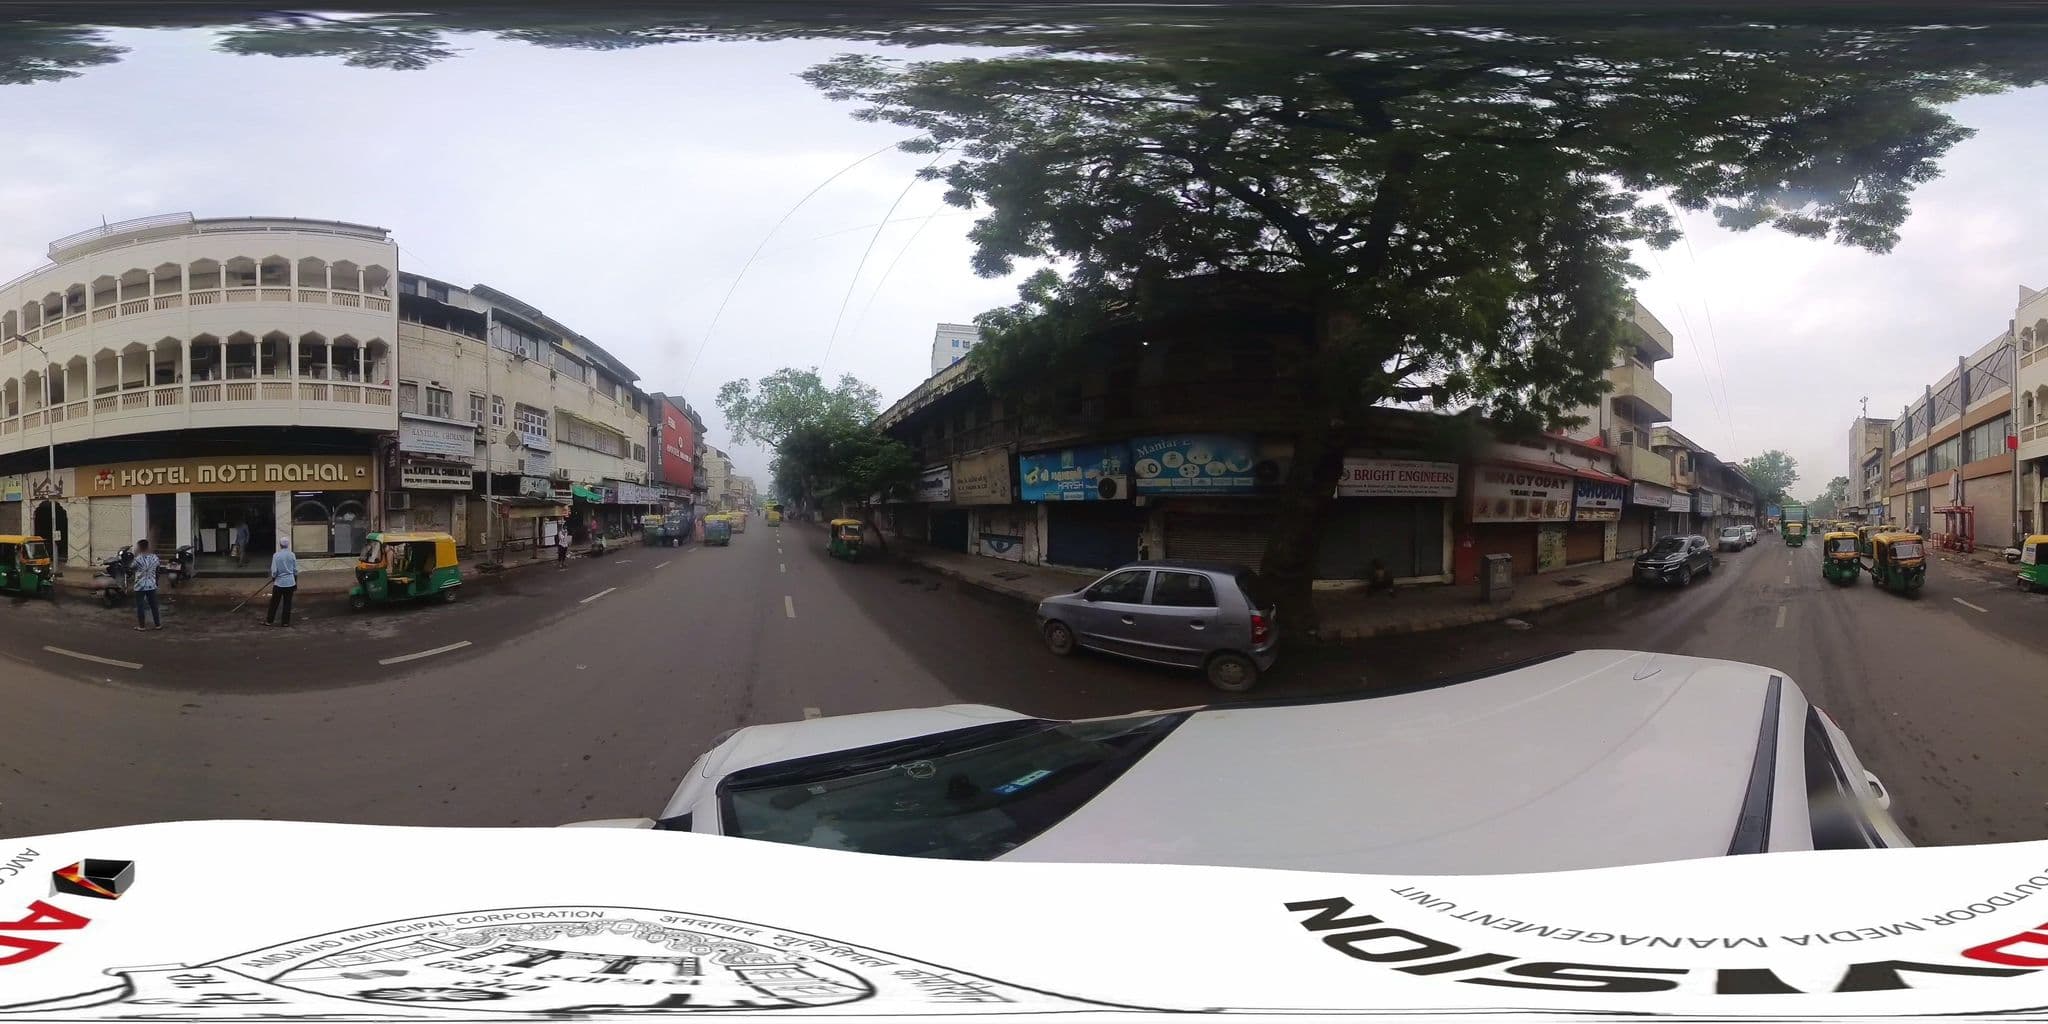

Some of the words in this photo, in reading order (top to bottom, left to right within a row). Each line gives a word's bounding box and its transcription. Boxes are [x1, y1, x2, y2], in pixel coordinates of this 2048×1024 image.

[121, 466, 190, 486] HOTEL
[1354, 469, 1396, 481] BRIGHT
[1399, 470, 1455, 484] ENGINEERS
